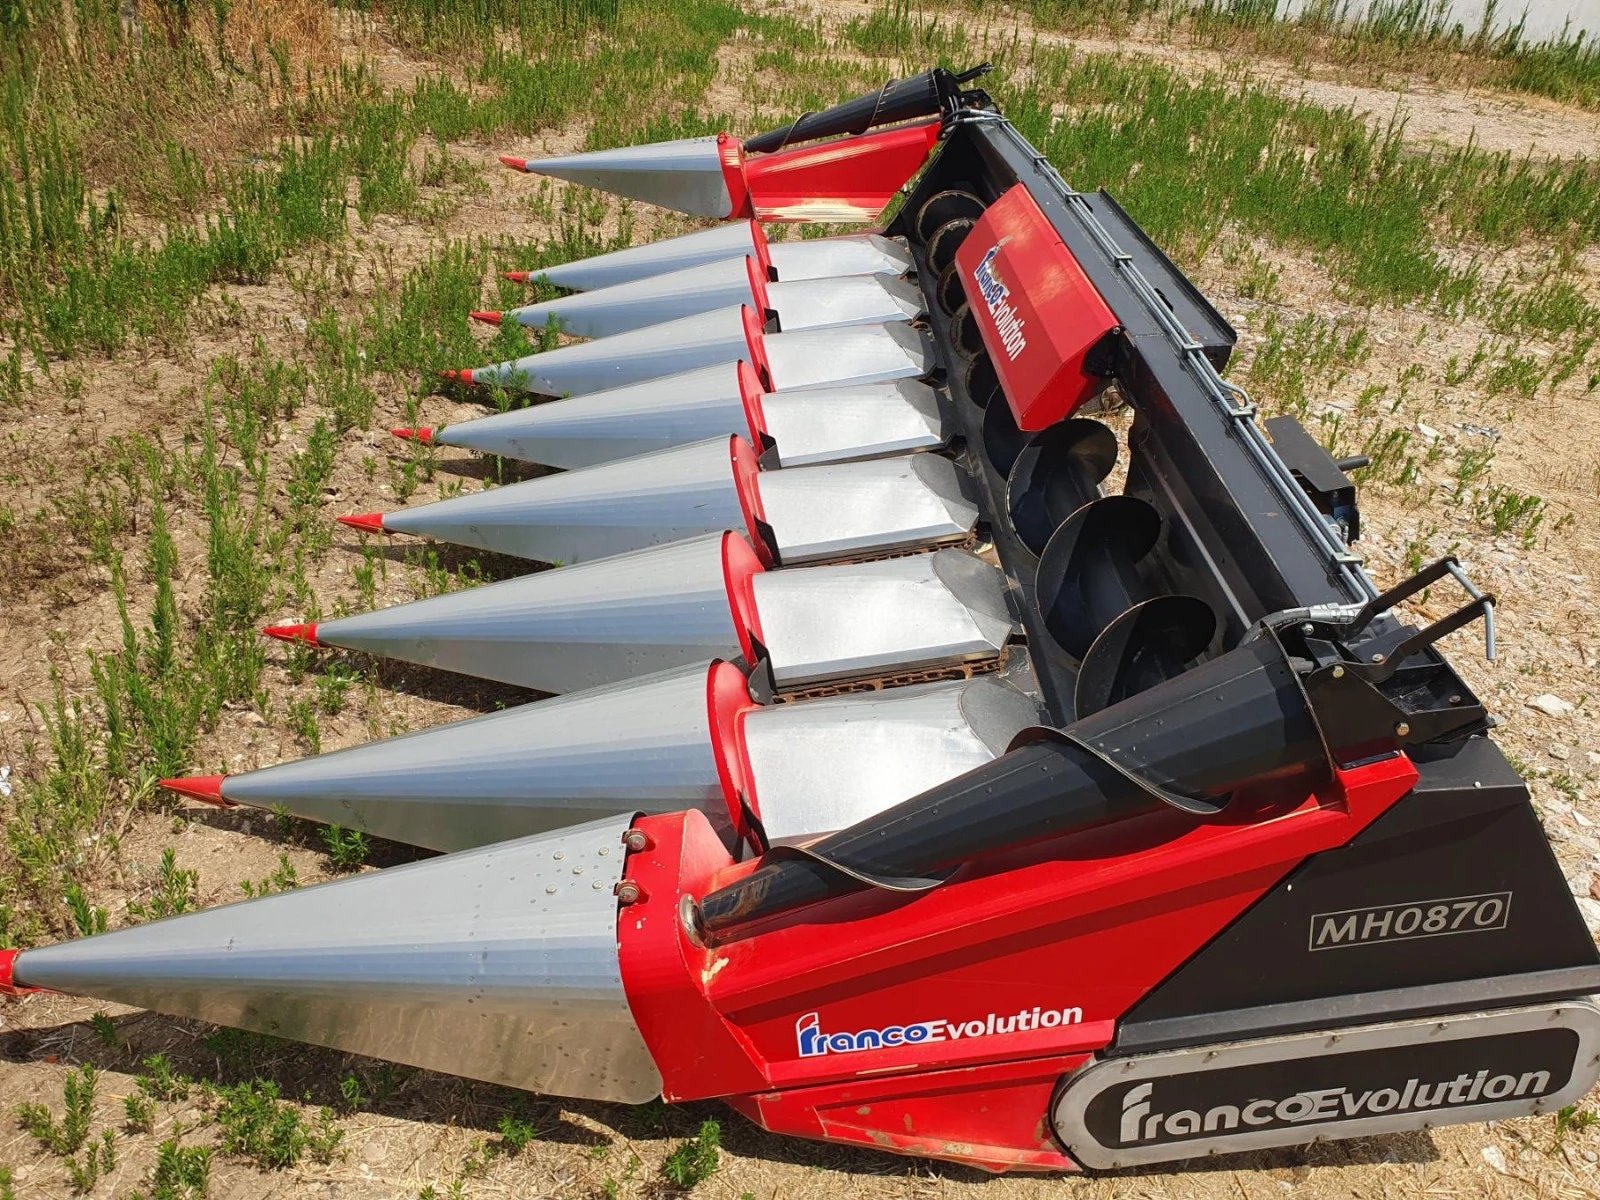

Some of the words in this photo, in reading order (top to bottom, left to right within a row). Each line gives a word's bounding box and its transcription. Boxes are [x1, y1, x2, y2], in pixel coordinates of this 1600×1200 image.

[1316, 899, 1503, 945] MH0870
[796, 1006, 1083, 1057] francoEvolution
[1120, 1069, 1551, 1143] francoEvolution
